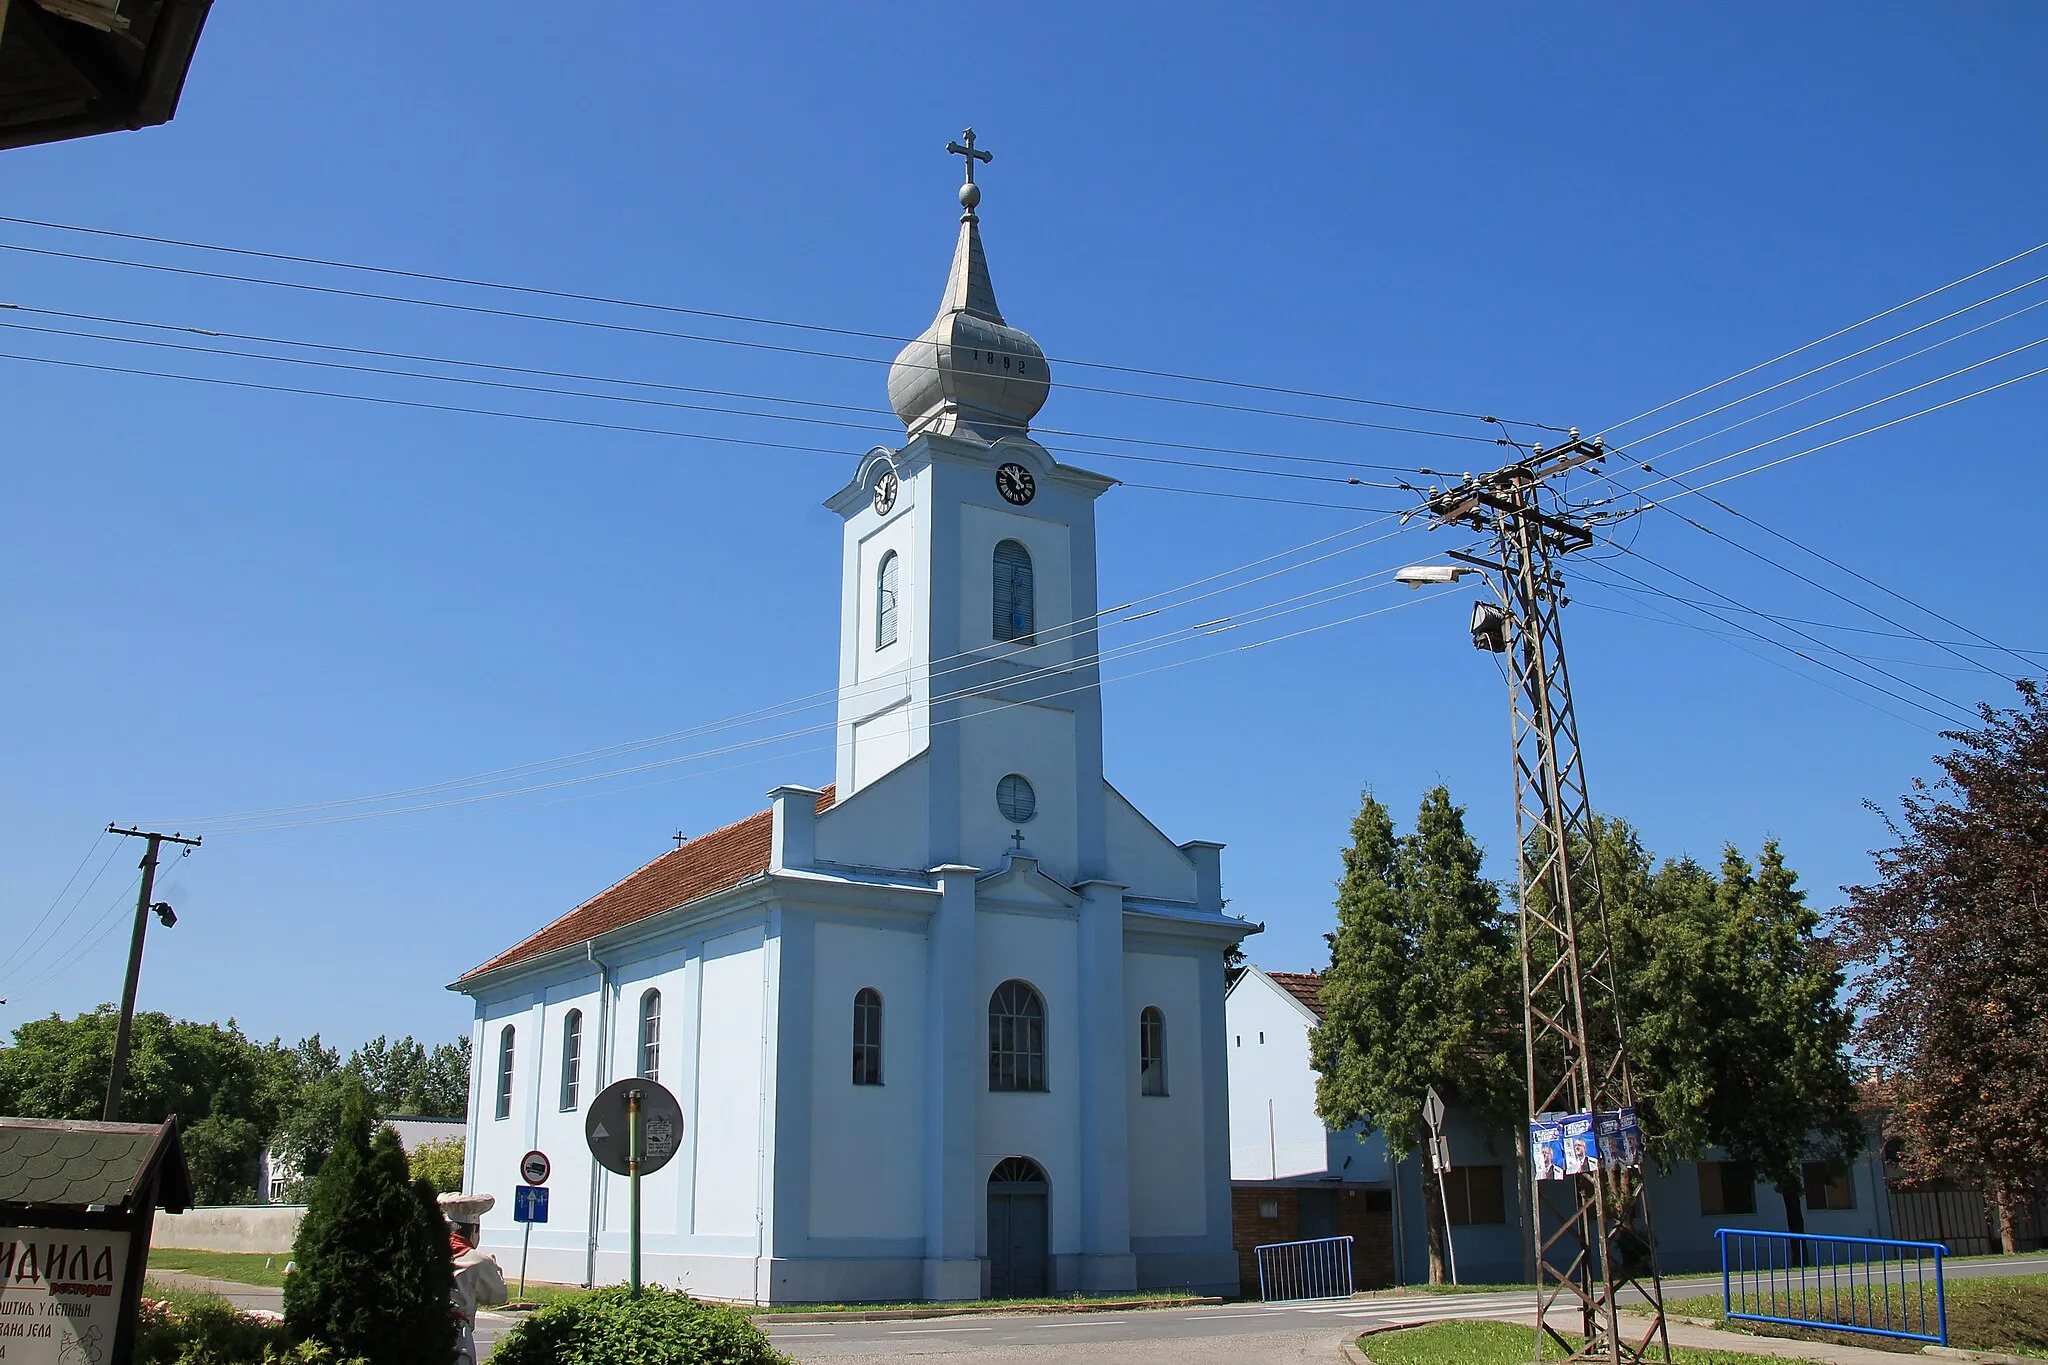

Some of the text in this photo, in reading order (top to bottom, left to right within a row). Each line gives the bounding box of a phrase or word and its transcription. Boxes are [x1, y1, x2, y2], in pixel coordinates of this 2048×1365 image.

[973, 347, 1026, 375] 1892
[0, 1301, 35, 1316] ШТИЉ
[39, 1302, 46, 1317] У
